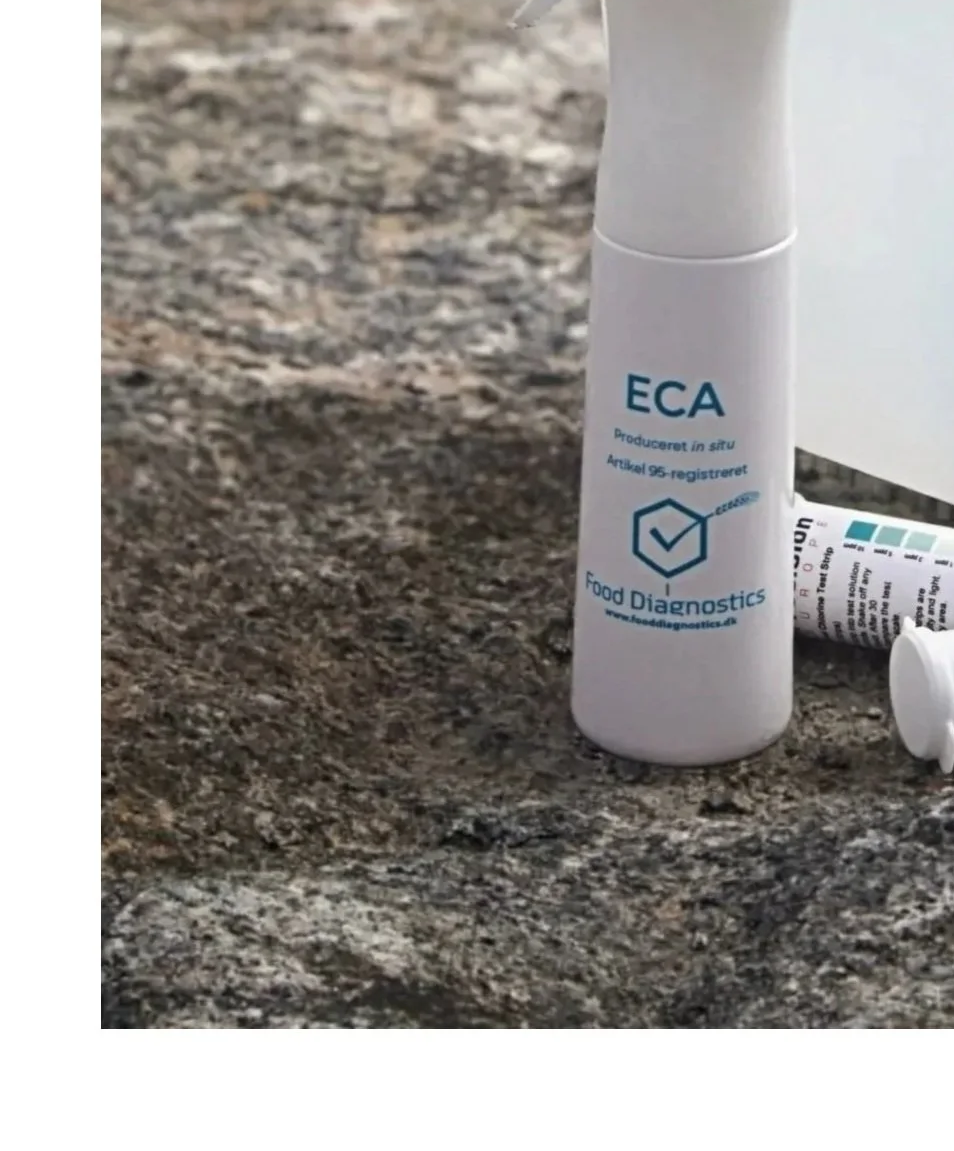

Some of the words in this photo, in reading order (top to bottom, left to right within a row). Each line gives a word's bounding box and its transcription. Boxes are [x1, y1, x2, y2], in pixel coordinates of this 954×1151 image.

[626, 373, 726, 418] ECA
[614, 427, 688, 452] Produceret
[690, 440, 705, 452] in
[708, 438, 736, 453] situ
[606, 454, 646, 476] Artikel
[648, 464, 748, 484] 95-registreret
[820, 546, 835, 571] Strip
[816, 573, 829, 593] Test
[847, 561, 862, 598] solution
[861, 567, 873, 585] any
[585, 570, 625, 607] Food
[630, 587, 767, 617] Diagnostics
[859, 586, 868, 600] off
[880, 581, 893, 599] test
[917, 587, 927, 604] are
[846, 599, 856, 617] test
[857, 601, 868, 629] Shake
[868, 599, 878, 612] 30
[880, 601, 890, 616] the
[927, 597, 937, 617] and
[604, 607, 739, 631] www.fooddiagnostics.dk
[868, 613, 879, 632] After
